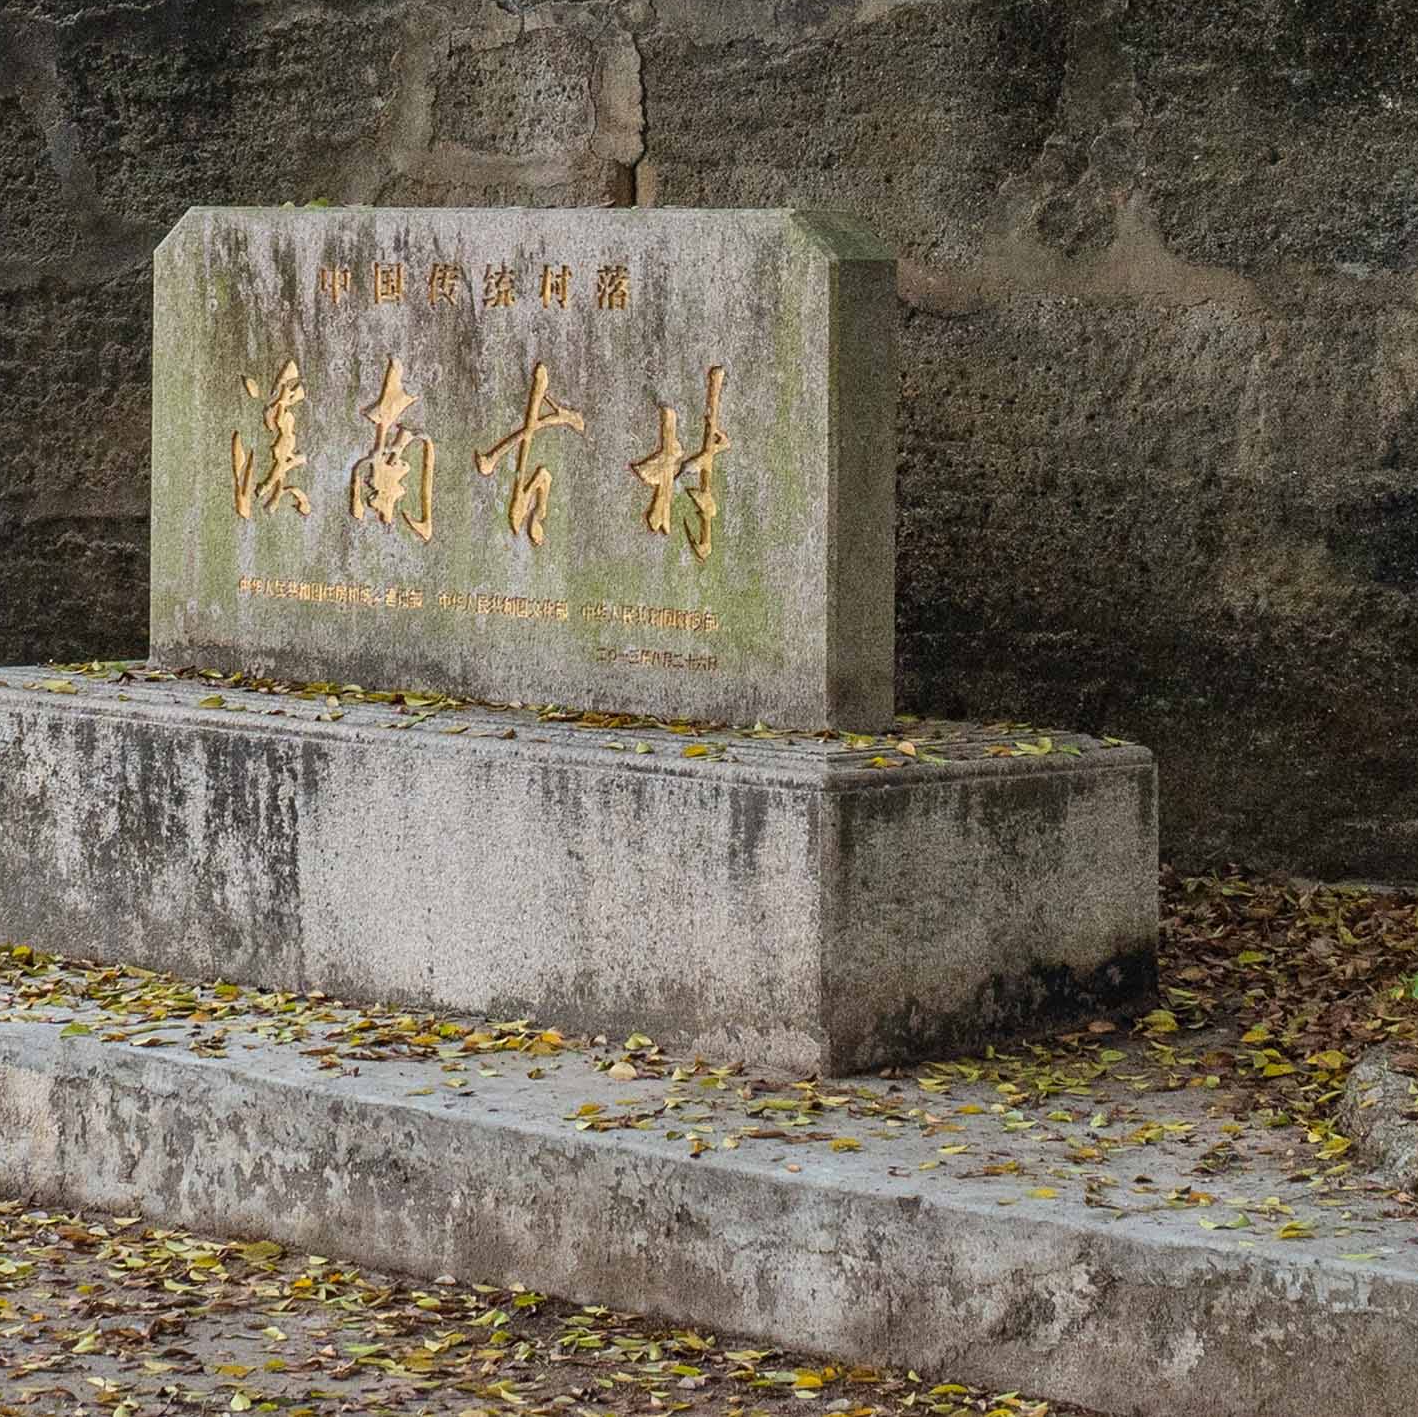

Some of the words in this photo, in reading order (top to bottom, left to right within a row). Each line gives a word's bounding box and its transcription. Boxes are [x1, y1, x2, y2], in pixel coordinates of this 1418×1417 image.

[319, 260, 632, 312] 中国传统村落
